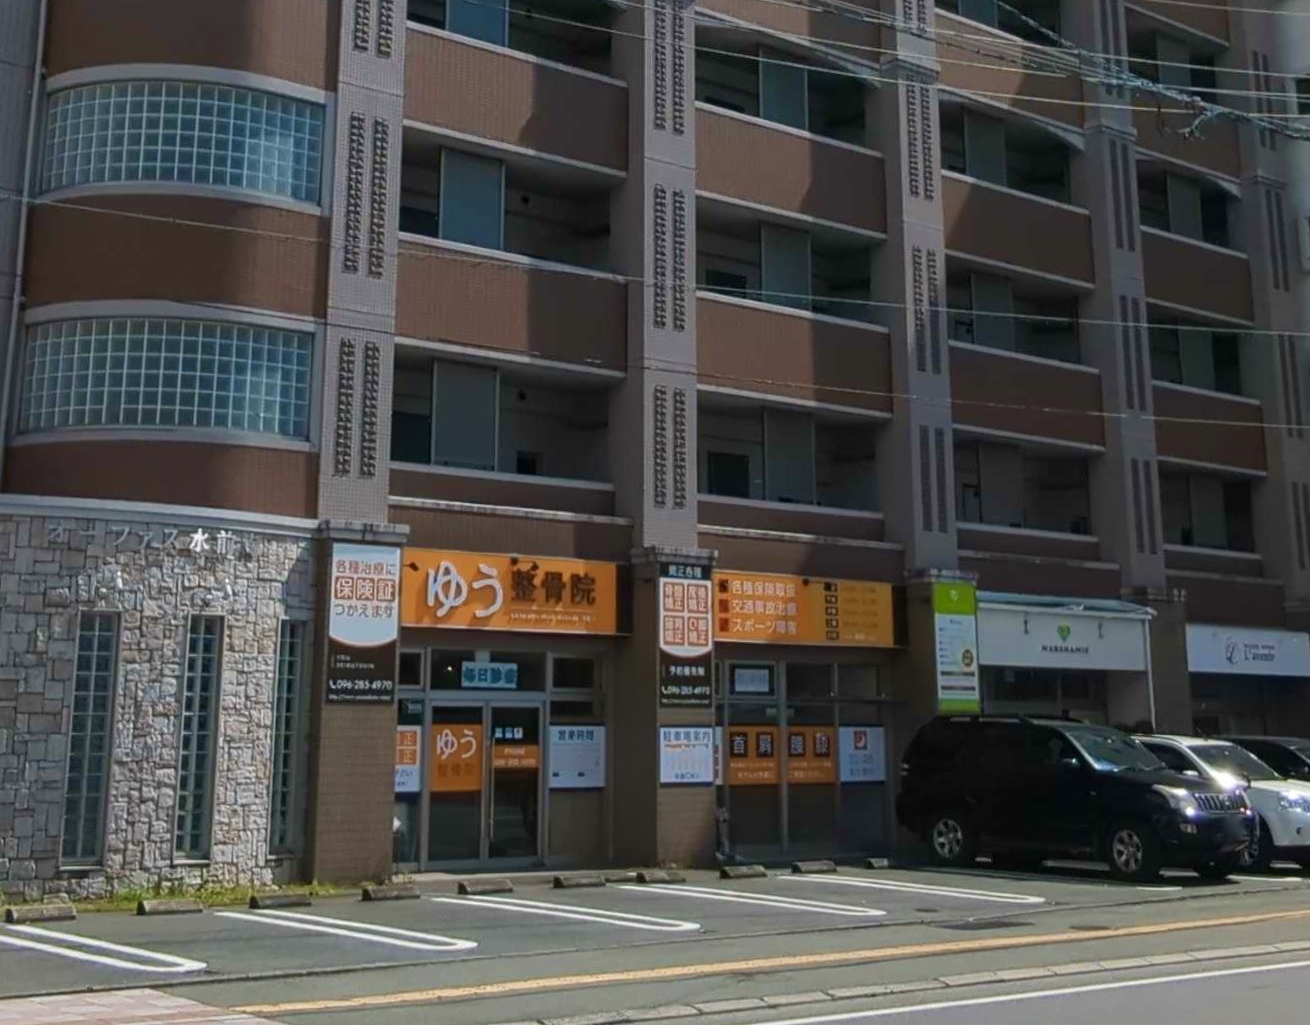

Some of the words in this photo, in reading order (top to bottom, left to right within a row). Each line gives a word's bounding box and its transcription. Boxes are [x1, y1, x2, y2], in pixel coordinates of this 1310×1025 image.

[335, 559, 396, 576] 各種治療に
[336, 578, 395, 601] 保険証
[427, 561, 504, 618] ゆう
[510, 567, 597, 606] 整骨院
[334, 603, 394, 619] つかえます
[436, 729, 477, 760] ゆう
